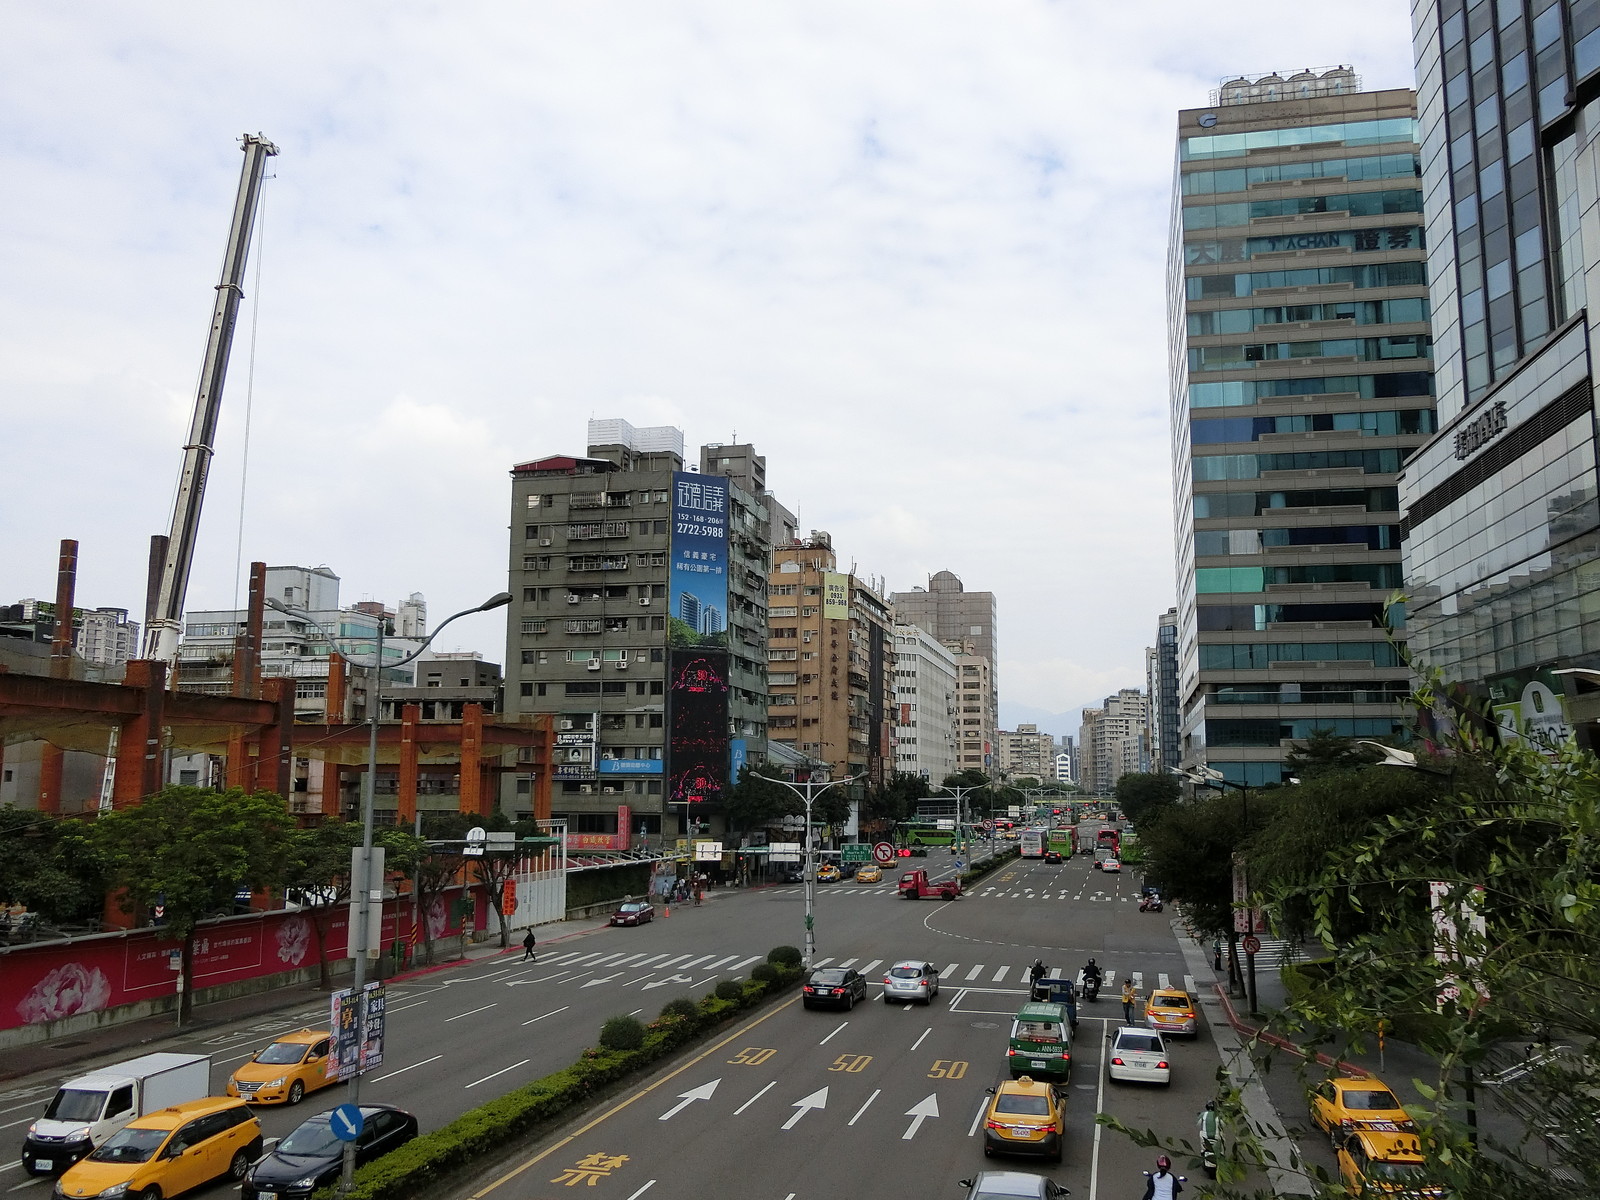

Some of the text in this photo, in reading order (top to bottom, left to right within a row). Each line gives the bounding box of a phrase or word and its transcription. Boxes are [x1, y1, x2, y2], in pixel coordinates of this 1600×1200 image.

[677, 523, 723, 538] 2722-5988
[342, 1007, 353, 1030] 享
[727, 1047, 777, 1066] 50
[828, 1053, 873, 1073] 50
[927, 1059, 969, 1079] 50
[550, 1152, 630, 1186] 禁
